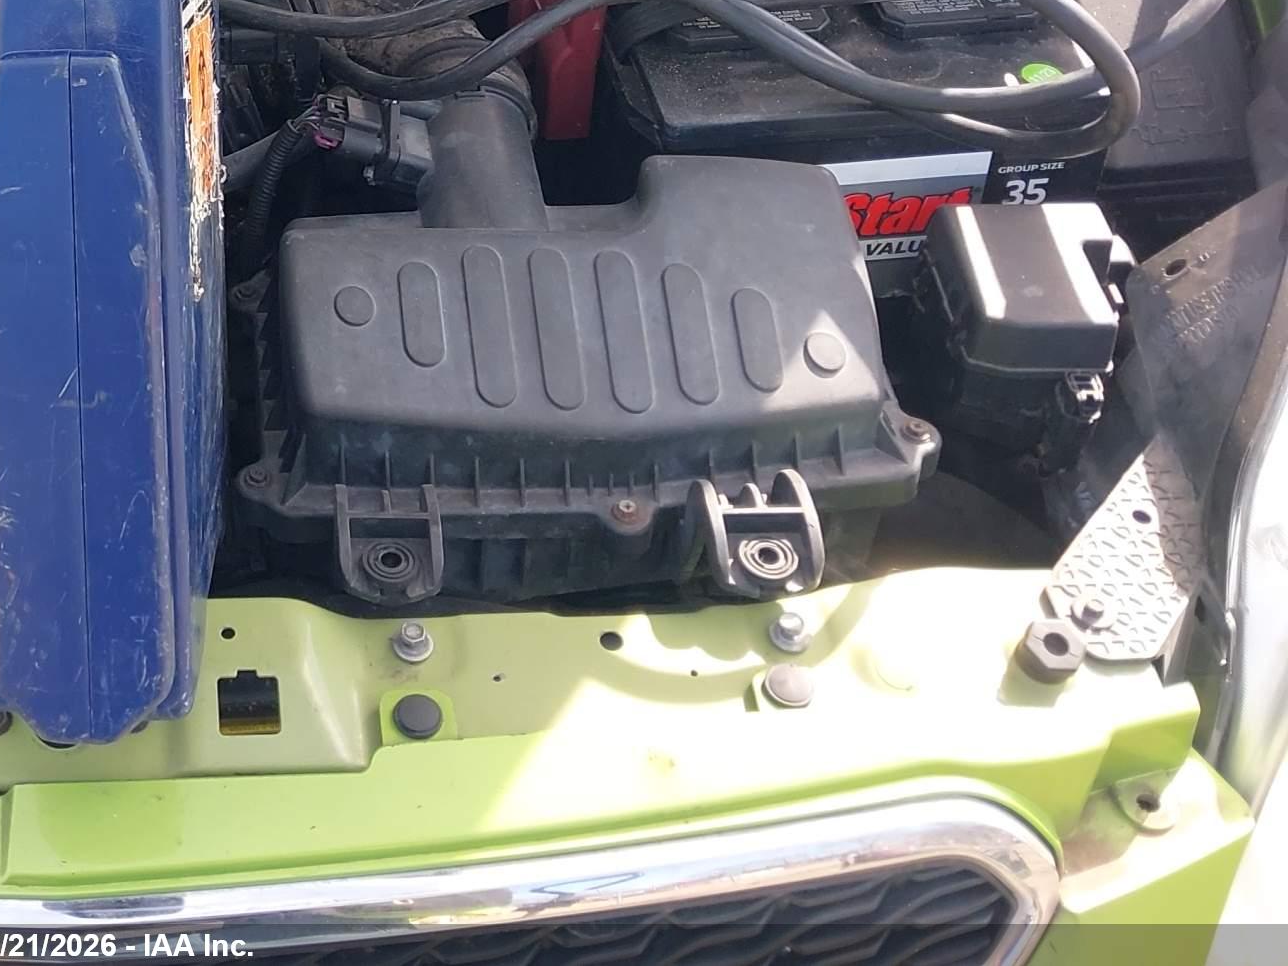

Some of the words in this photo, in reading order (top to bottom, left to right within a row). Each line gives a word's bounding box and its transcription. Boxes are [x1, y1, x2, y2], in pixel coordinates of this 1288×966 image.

[997, 163, 1039, 175] GROUP
[1040, 161, 1066, 172] SIZE
[1003, 178, 1050, 205] 35
